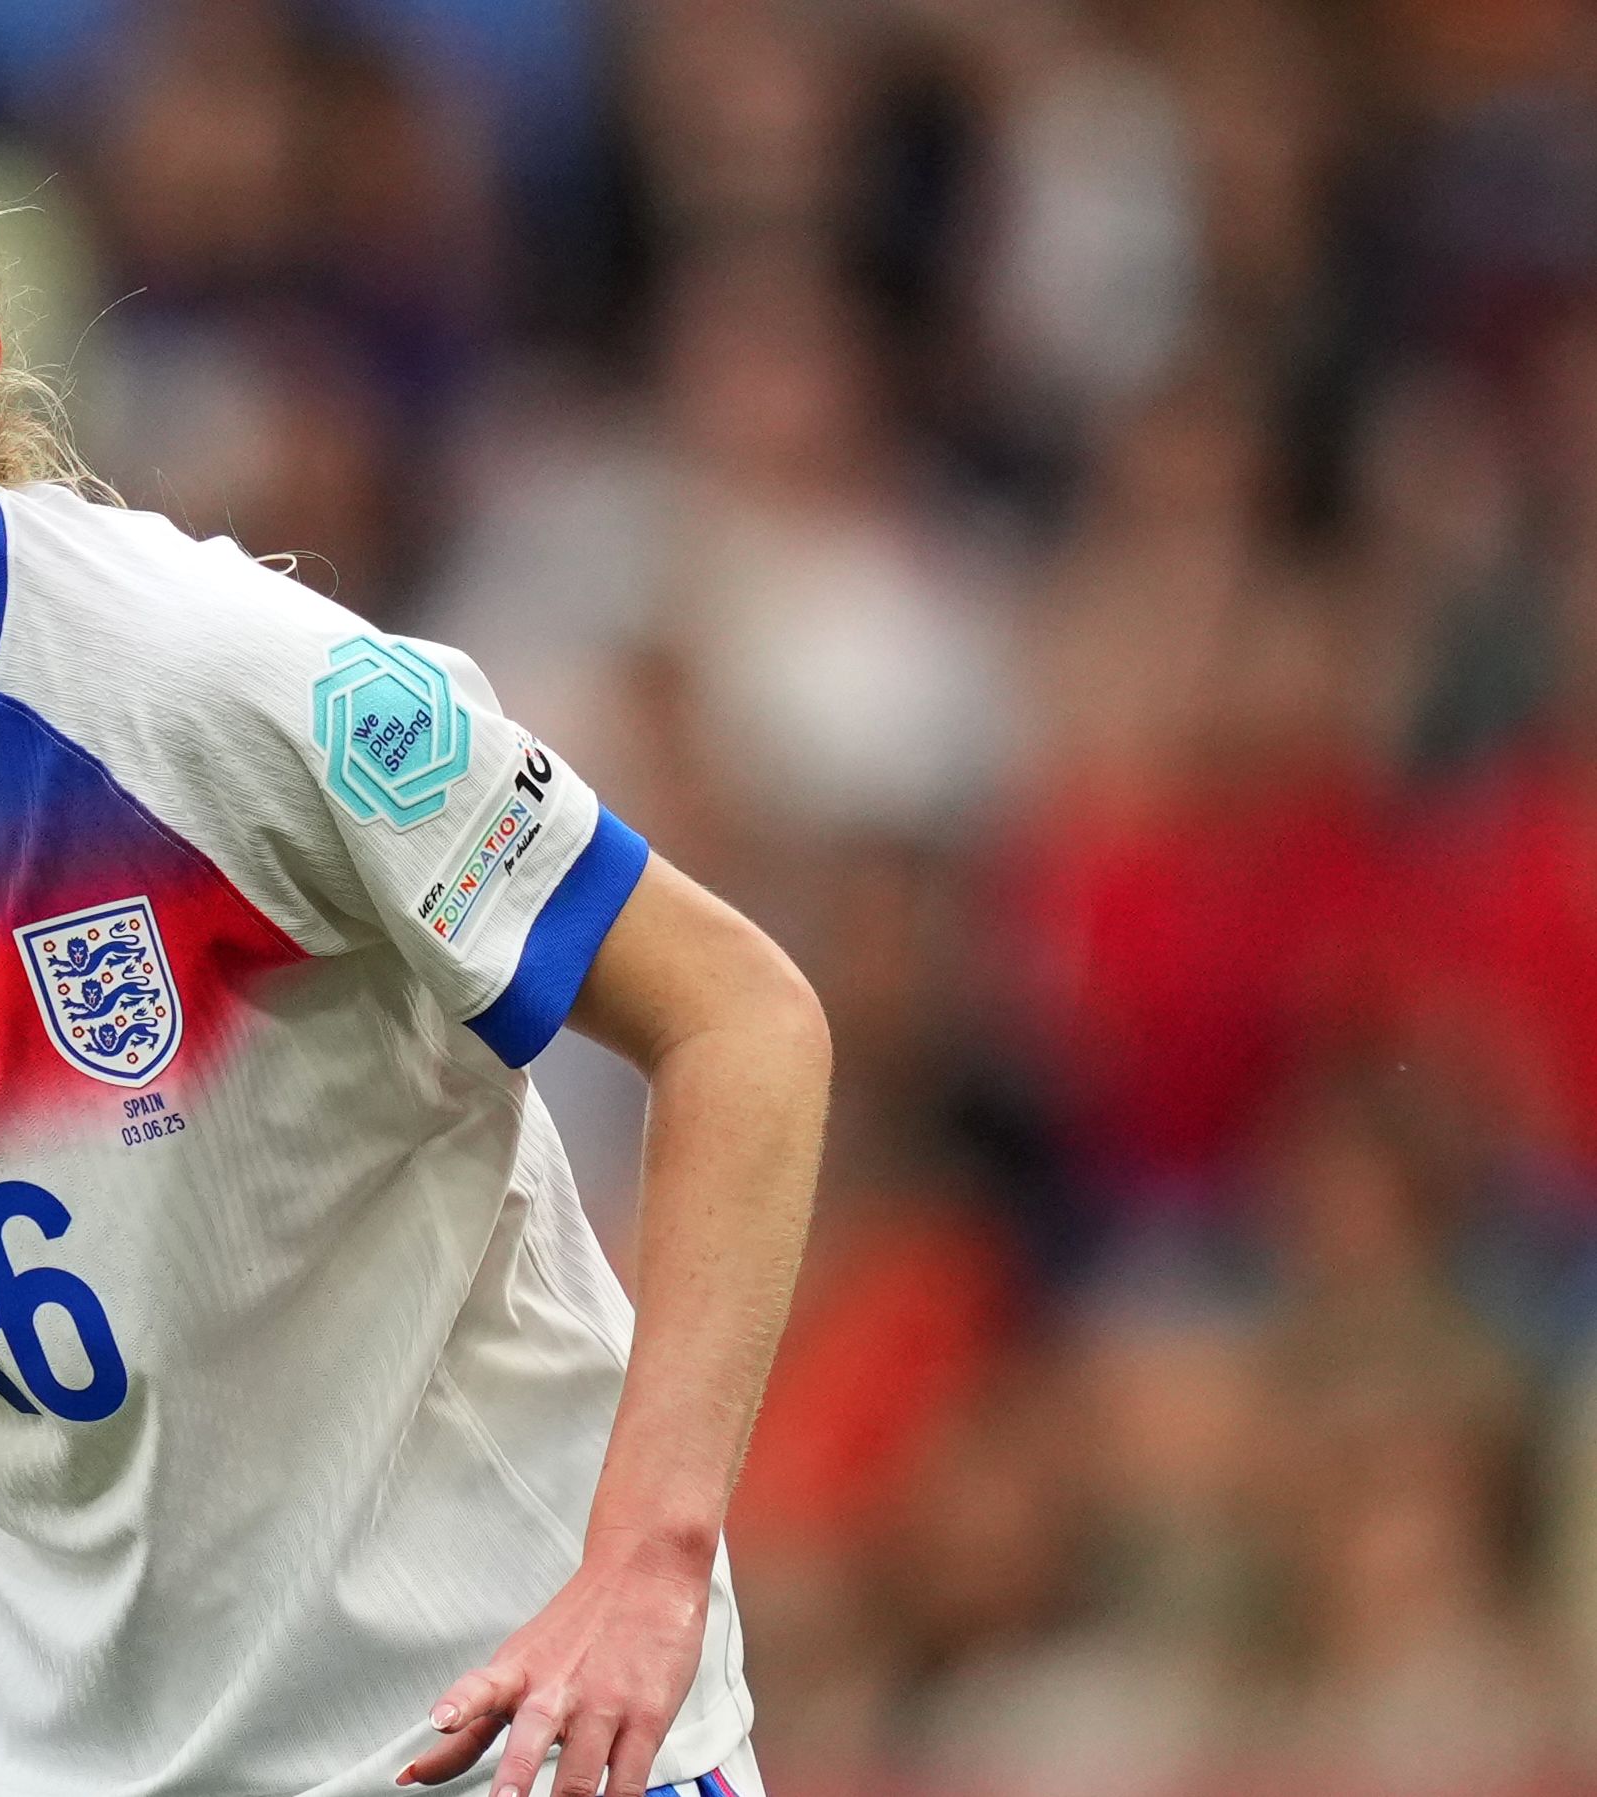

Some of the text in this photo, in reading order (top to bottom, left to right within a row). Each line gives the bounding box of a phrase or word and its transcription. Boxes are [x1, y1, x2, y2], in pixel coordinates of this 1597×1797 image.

[353, 713, 379, 743] We
[370, 716, 404, 759] Play
[385, 708, 432, 772] Strong
[433, 800, 529, 938] FOUNDATION
[504, 822, 543, 877] for children
[417, 883, 446, 920] UEFA
[123, 1092, 165, 1119] SPAIN
[121, 1114, 186, 1147] 03.06.25
